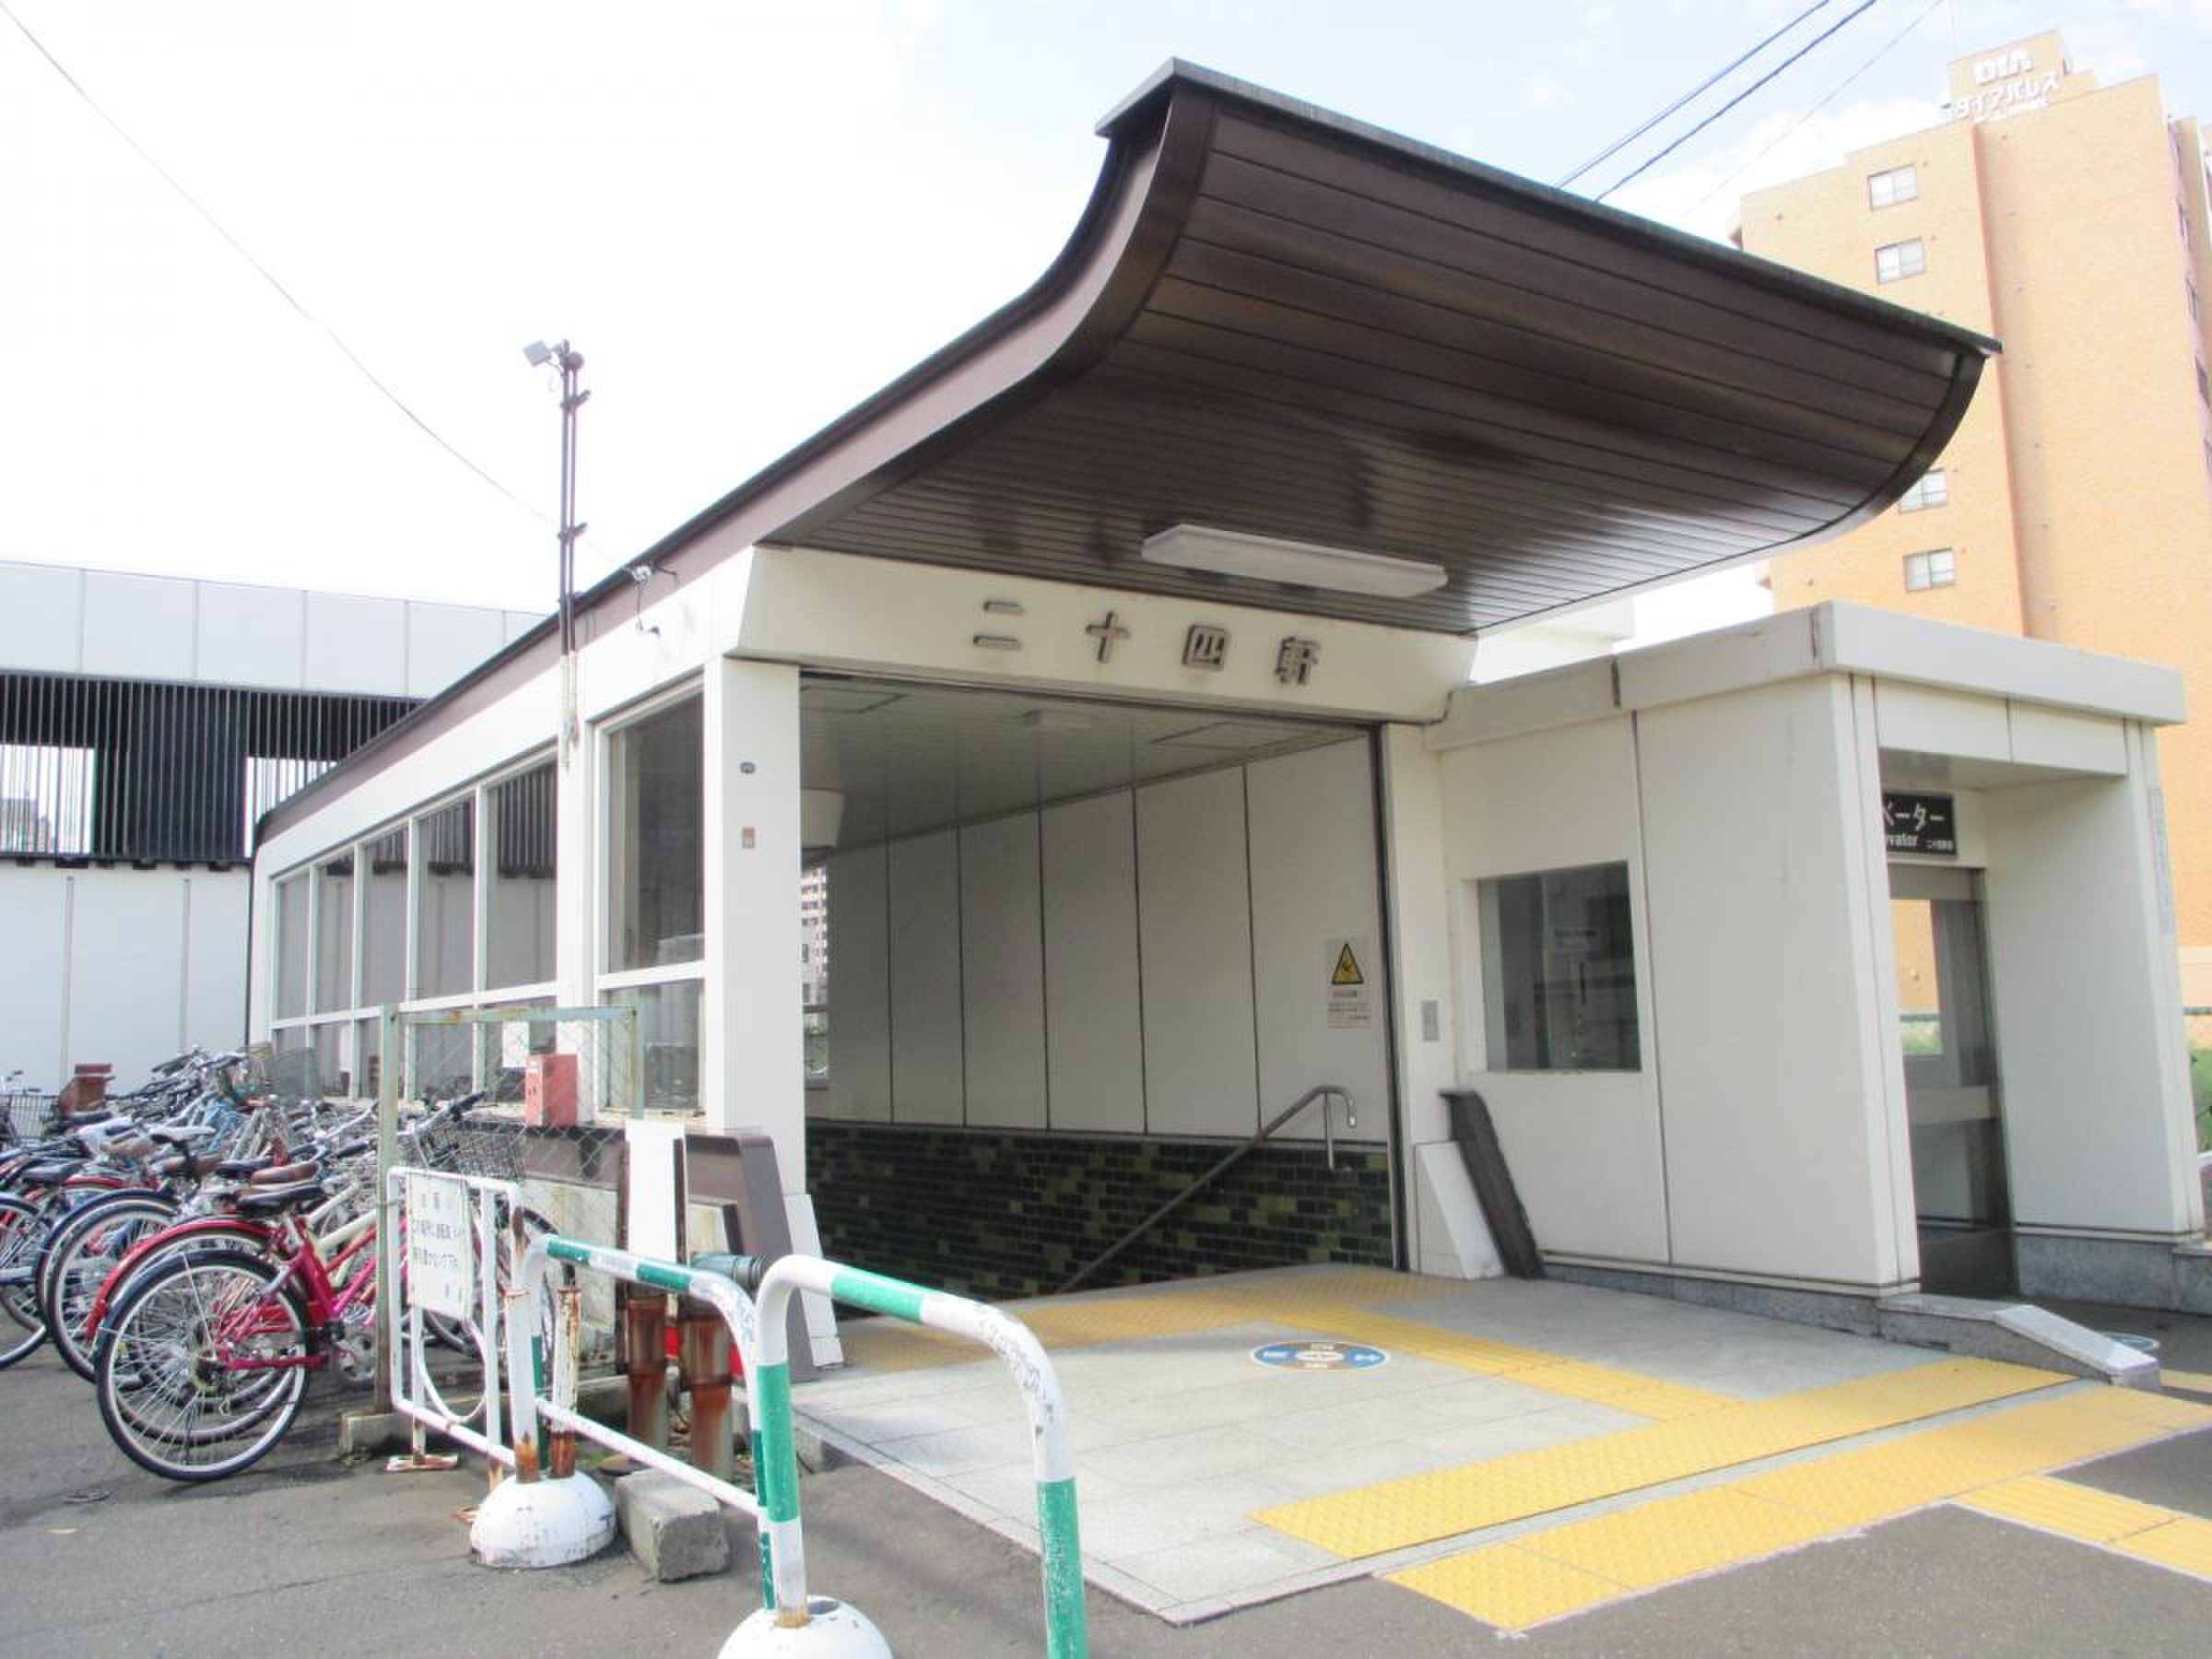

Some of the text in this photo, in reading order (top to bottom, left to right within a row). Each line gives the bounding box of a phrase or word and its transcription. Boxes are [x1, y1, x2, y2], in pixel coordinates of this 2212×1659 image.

[1974, 49, 2033, 83] DIA
[973, 600, 1322, 685] 二十四軒
